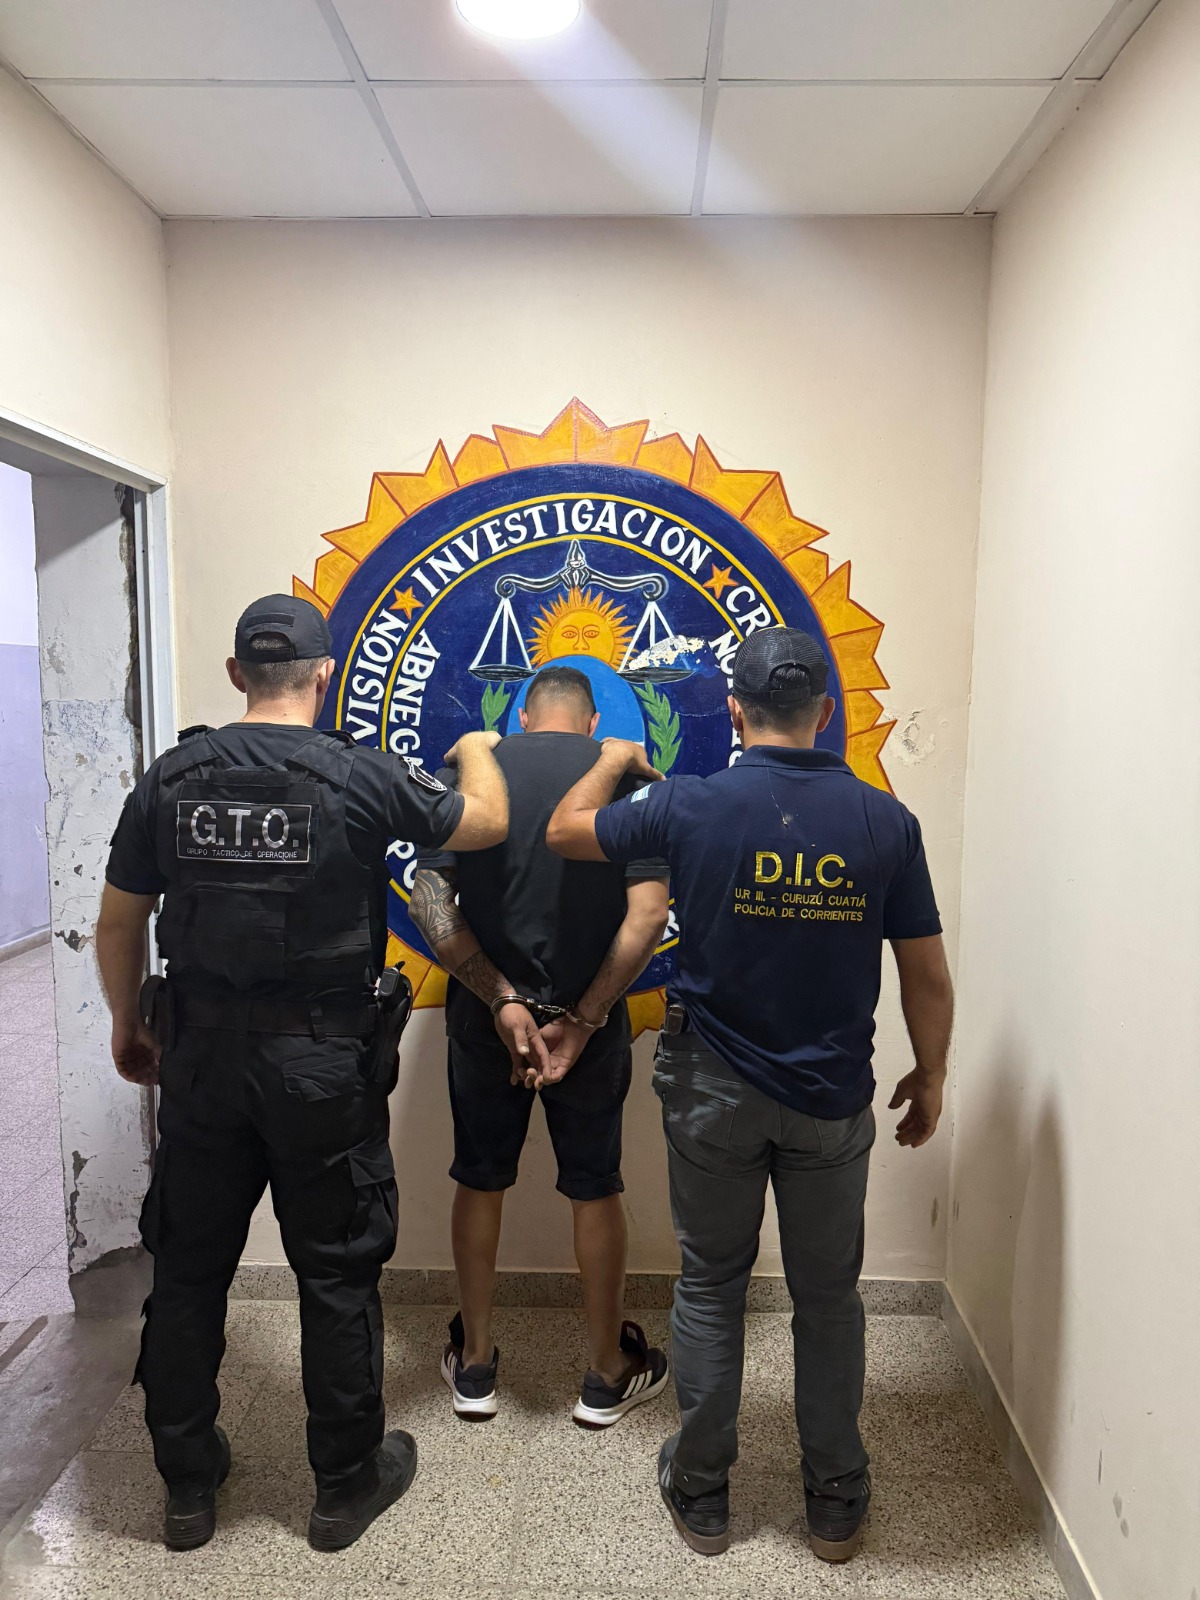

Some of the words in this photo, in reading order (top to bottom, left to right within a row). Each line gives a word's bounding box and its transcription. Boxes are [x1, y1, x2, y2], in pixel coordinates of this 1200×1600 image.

[346, 608, 409, 749] VISIÓN
[411, 499, 712, 598] INVESTIGACIÓN
[190, 805, 299, 848] G.T.O.
[186, 847, 208, 856] GRUPO
[244, 850, 254, 858] DE
[755, 851, 853, 888] D.I.C.
[734, 903, 776, 916] POLICIA
[781, 907, 796, 917] DE
[800, 908, 863, 922] CORRIENTES
[781, 891, 823, 905] CURUZÚ
[828, 893, 866, 908] CUATIÁ
